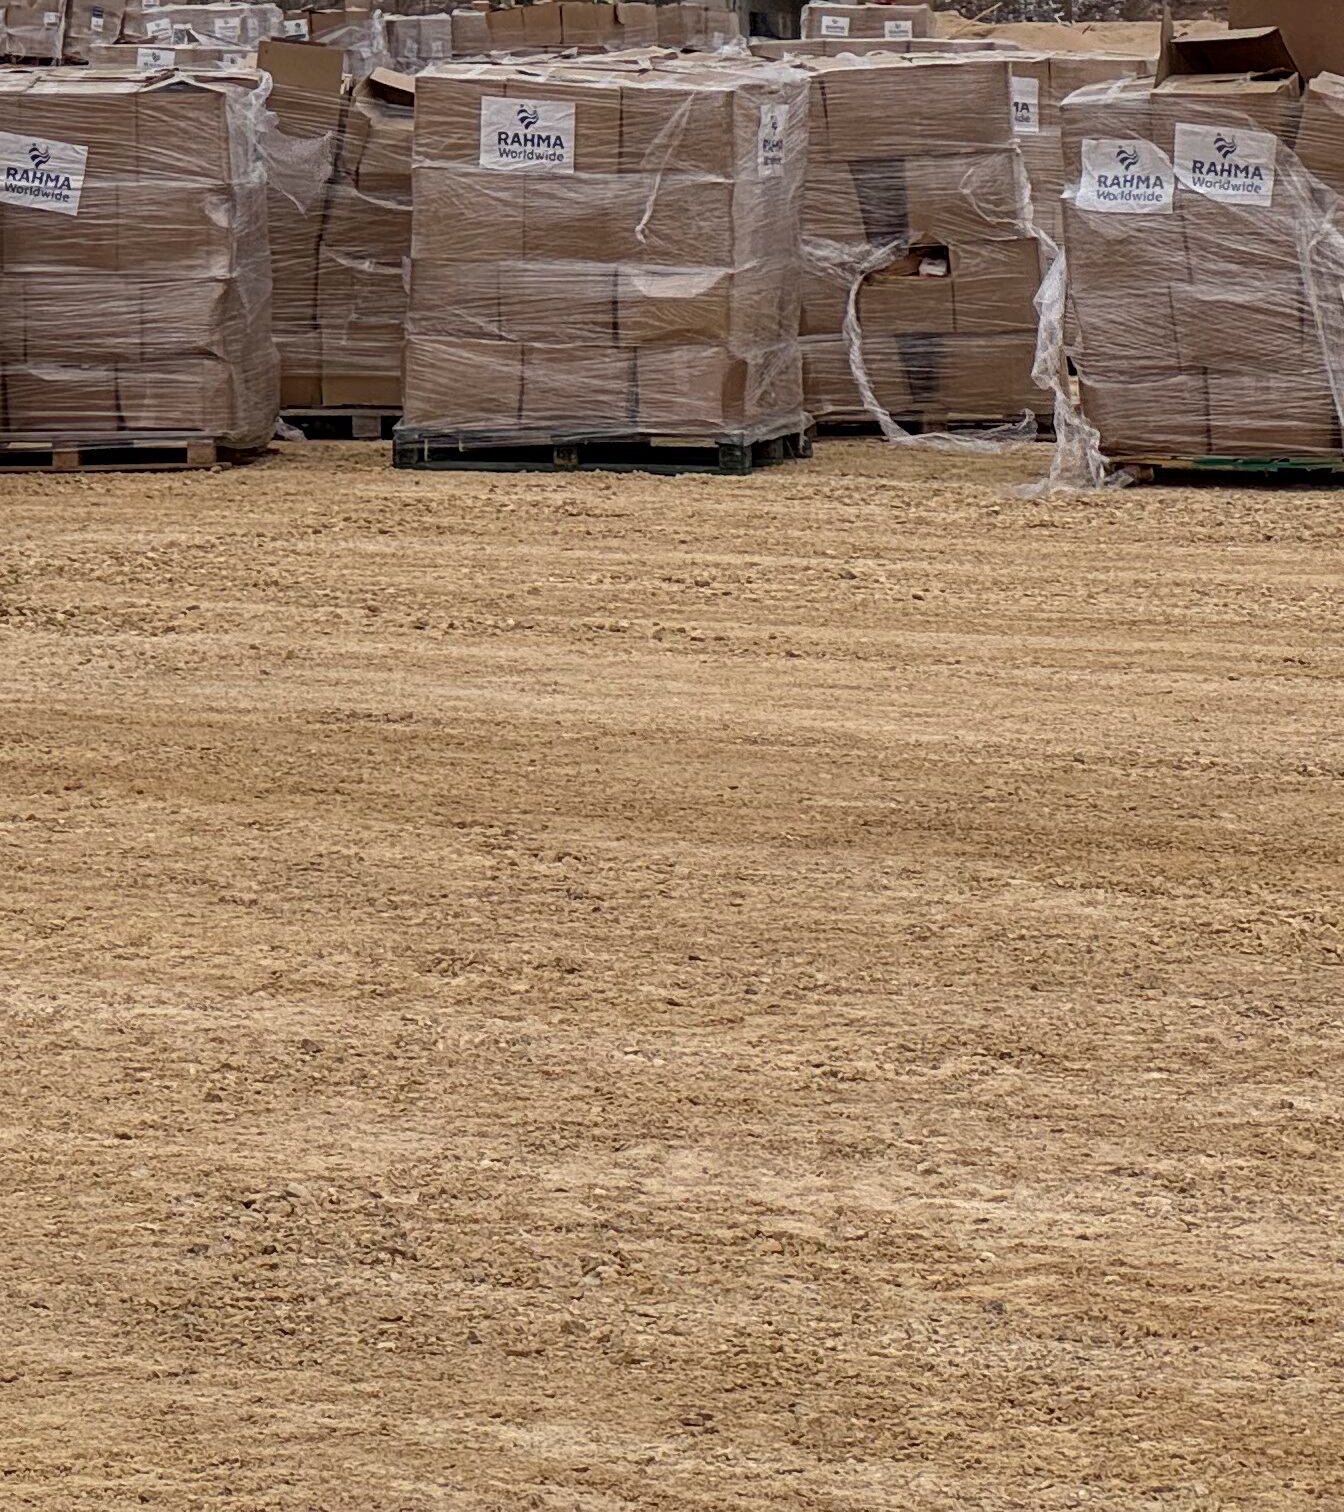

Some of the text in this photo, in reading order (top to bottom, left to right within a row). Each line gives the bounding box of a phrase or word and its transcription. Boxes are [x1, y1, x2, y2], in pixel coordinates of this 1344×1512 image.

[497, 131, 564, 150] RAHMA
[498, 148, 564, 162] Worldwide
[6, 166, 72, 190] RAHMA
[1192, 160, 1264, 180] RAHMA
[1098, 174, 1164, 190] RAHMA
[1192, 176, 1262, 194] Worldwide
[4, 182, 70, 202] Worldwide
[1096, 189, 1163, 202] Worldwide
